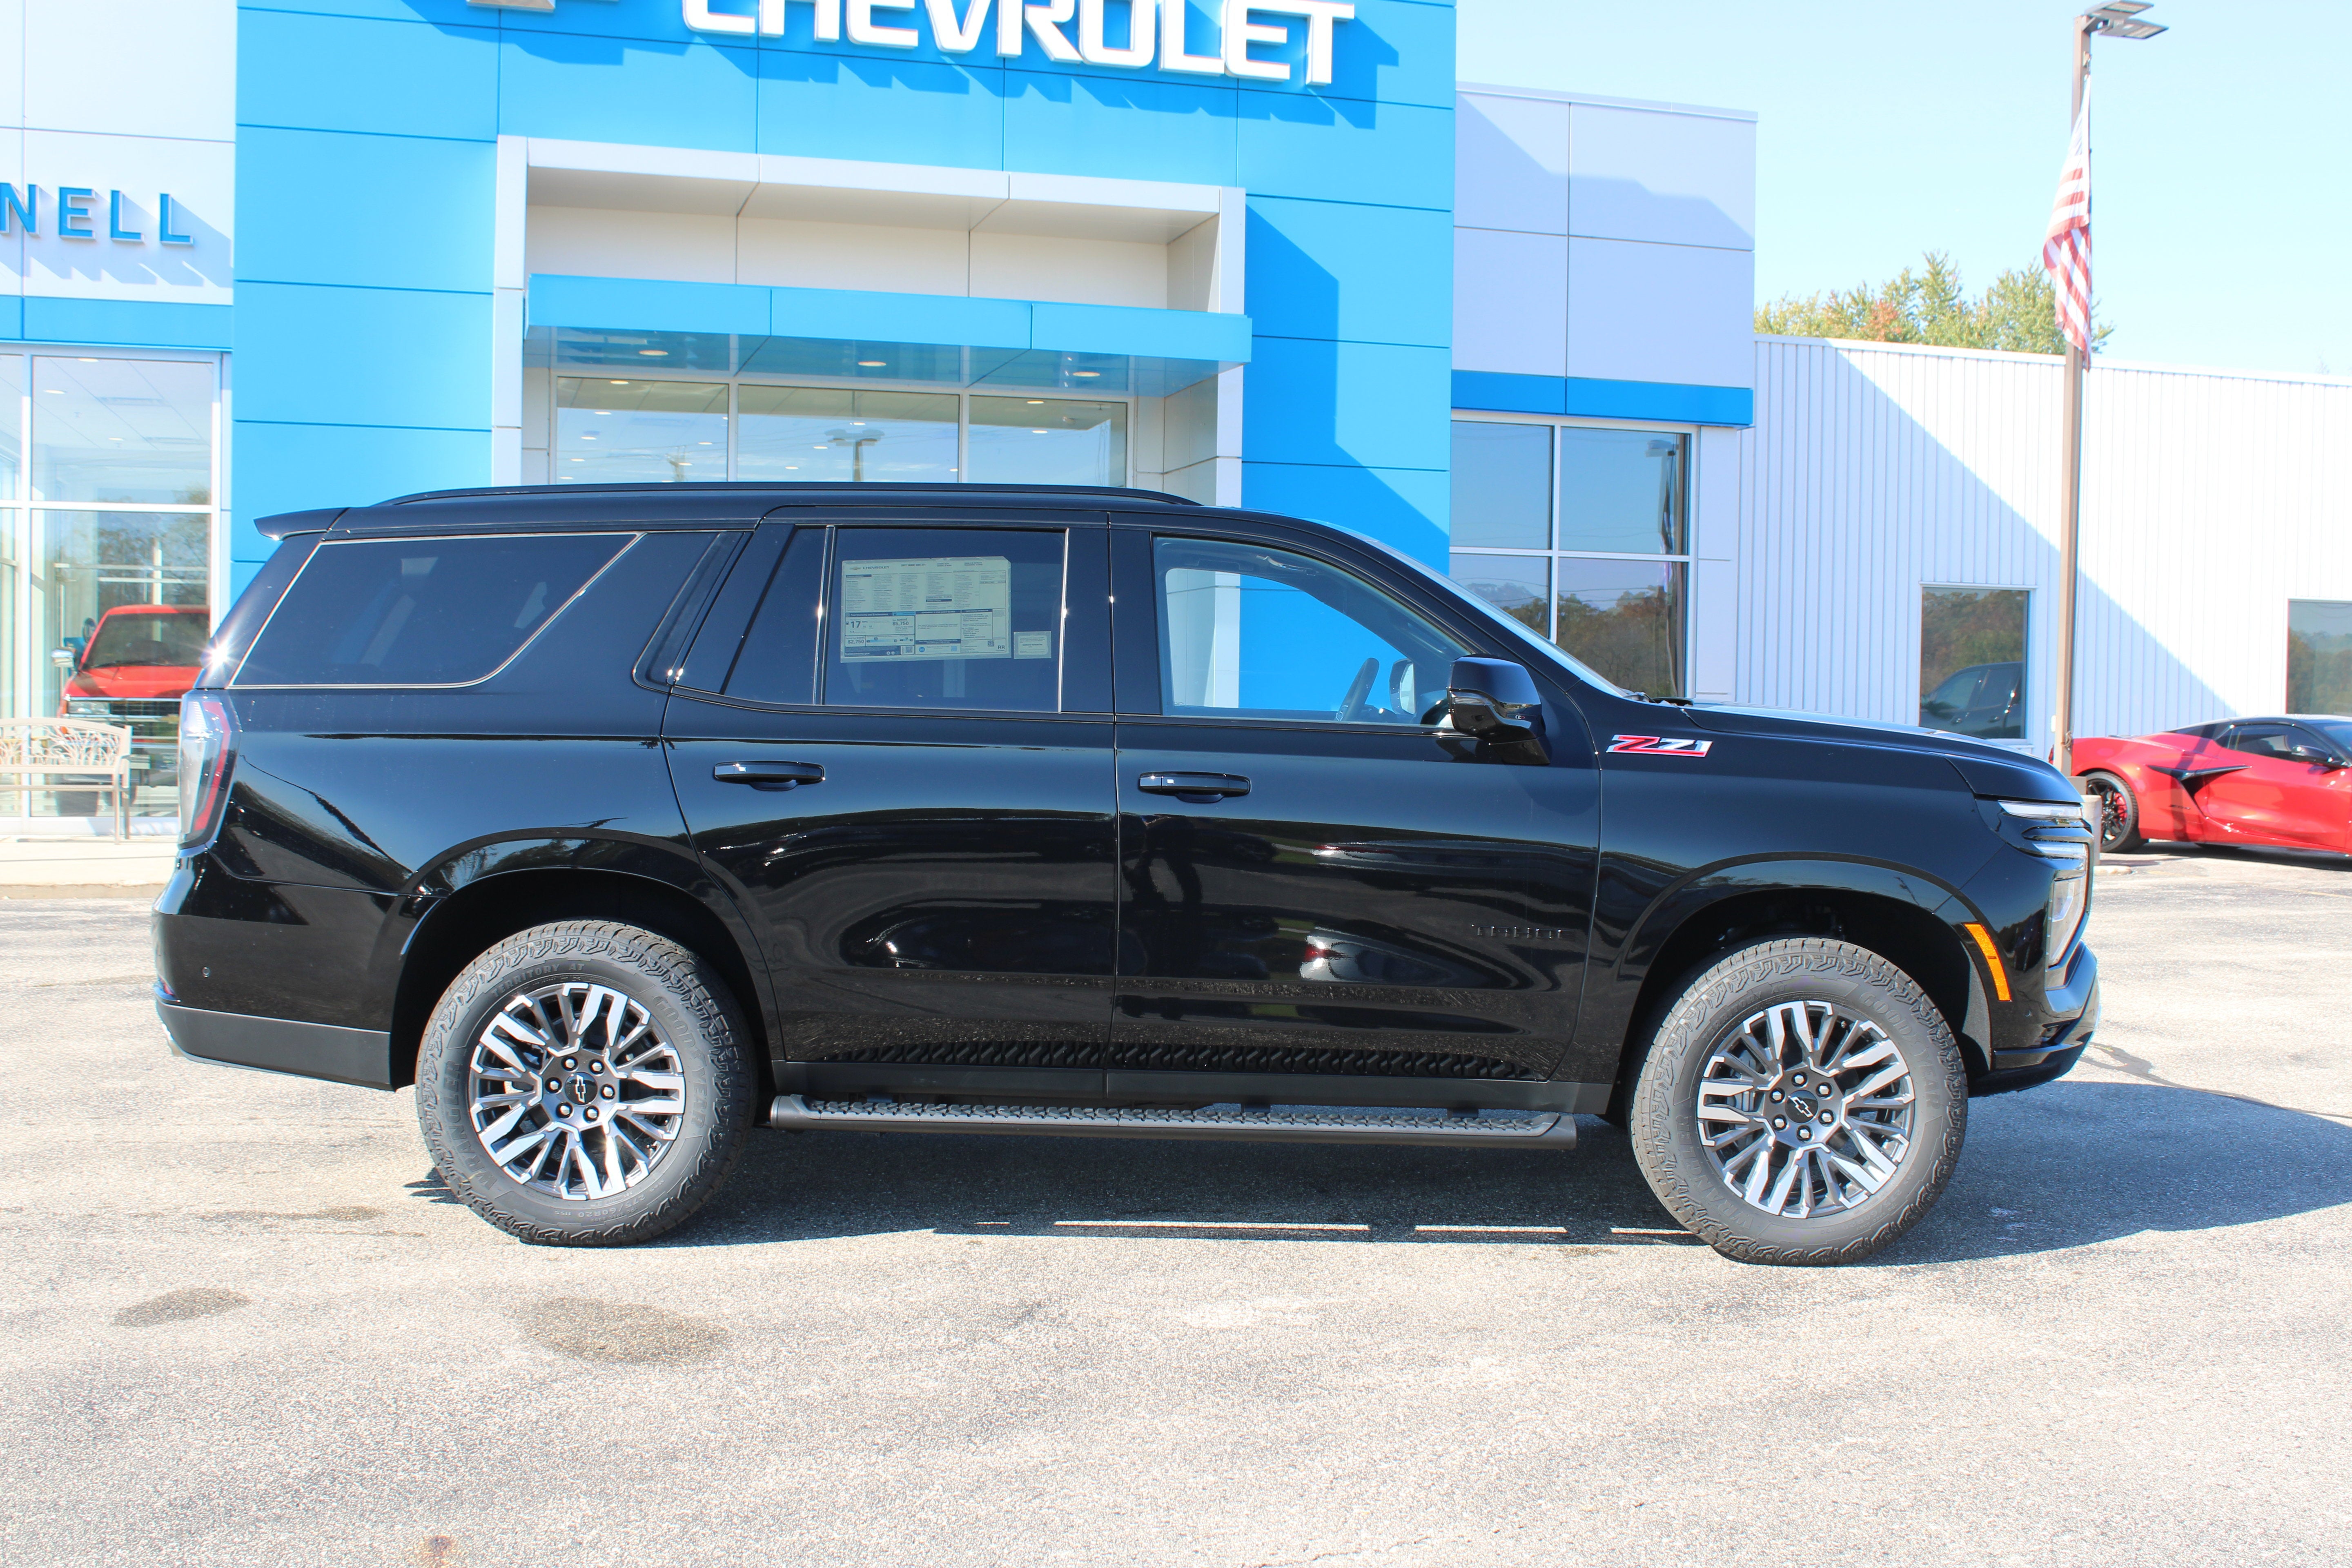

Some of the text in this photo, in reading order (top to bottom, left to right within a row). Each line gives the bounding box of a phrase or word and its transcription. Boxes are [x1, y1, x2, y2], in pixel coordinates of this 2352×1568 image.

[0, 182, 194, 245] NELL
[1606, 734, 1713, 757] Z71
[491, 962, 585, 996] TERRITORY AT
[443, 1061, 497, 1190] WRANGLER
[1675, 1115, 1755, 1230] WRANGLER
[578, 1193, 646, 1218] 275/60R20
[1842, 1188, 1902, 1231] 275/60R20
